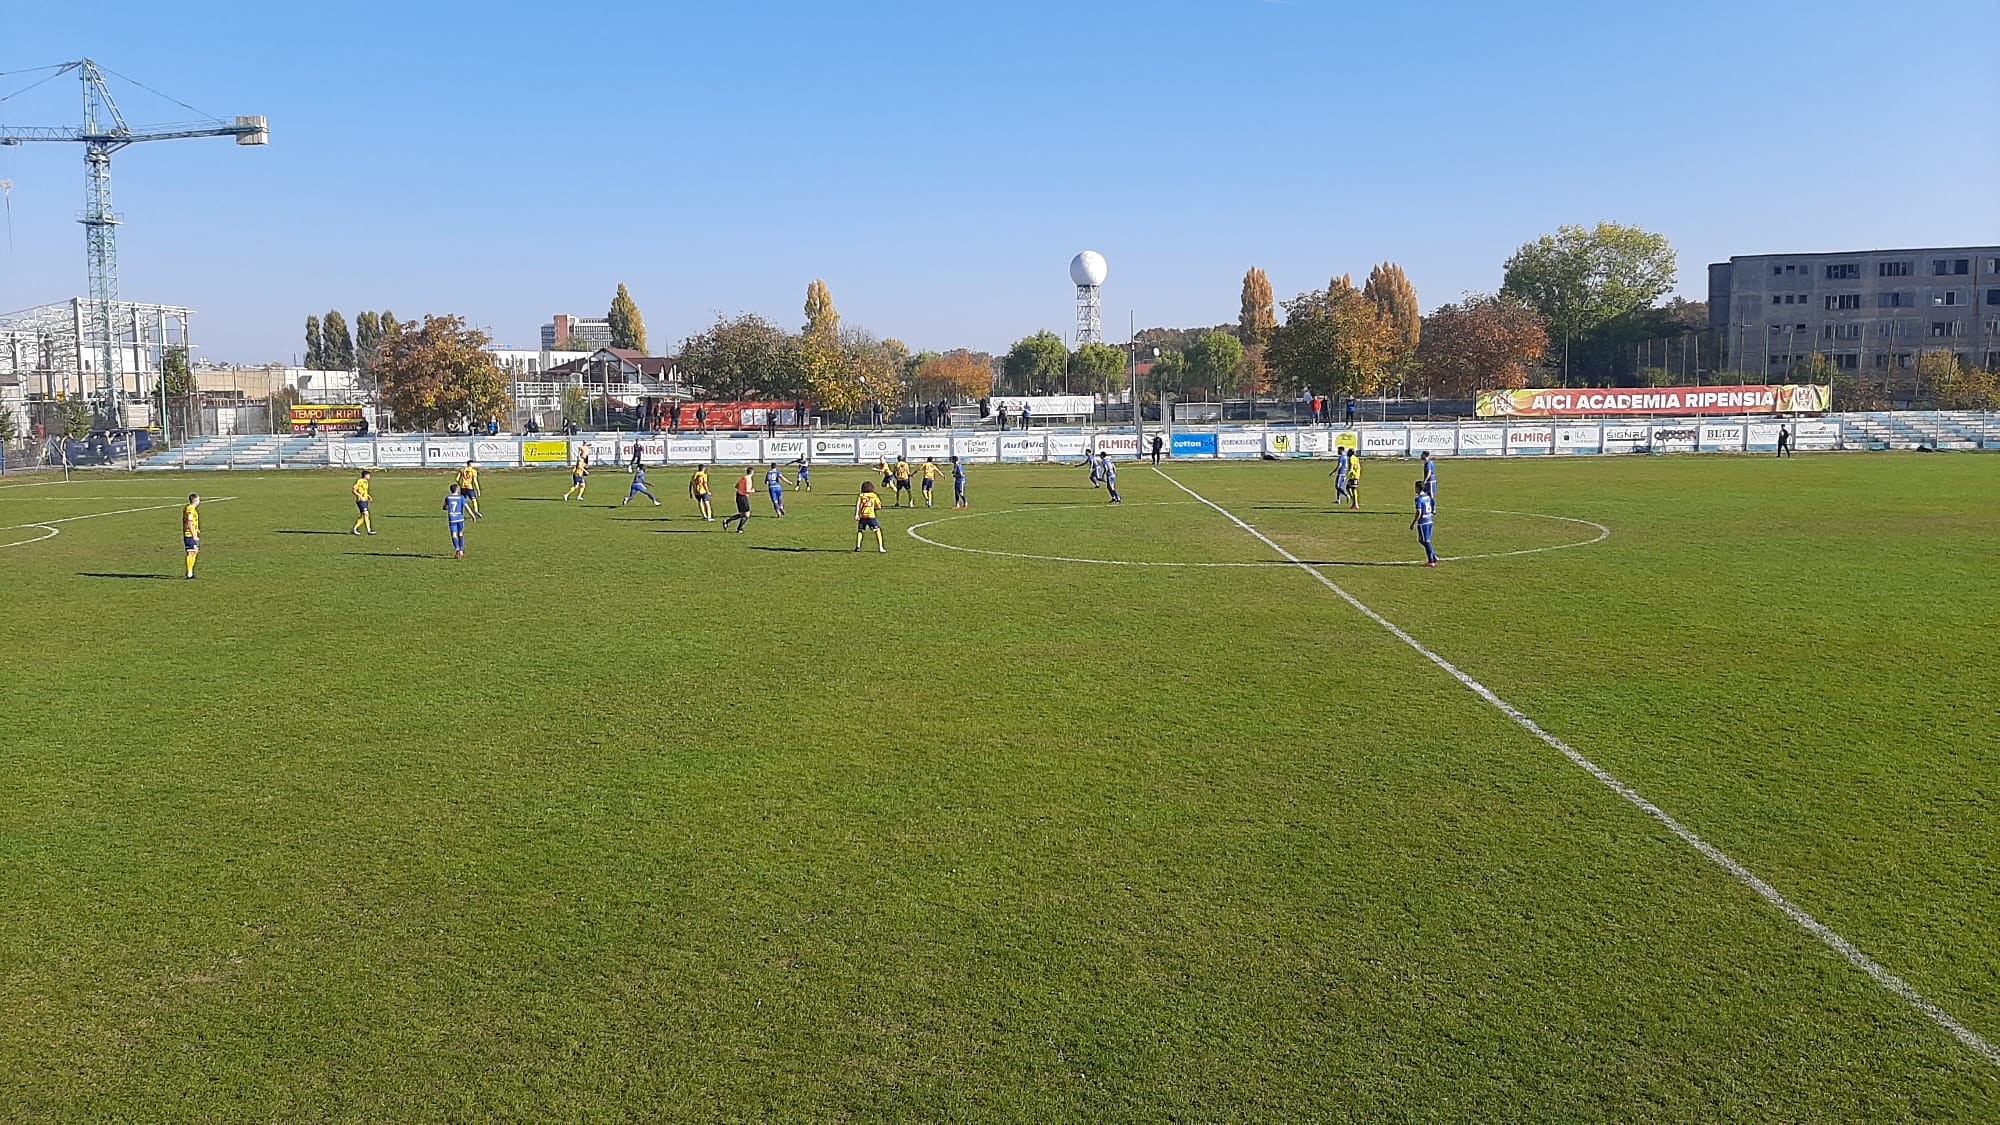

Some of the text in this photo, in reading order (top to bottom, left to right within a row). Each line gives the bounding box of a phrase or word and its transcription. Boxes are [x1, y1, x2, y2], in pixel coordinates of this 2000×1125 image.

[1532, 391, 1775, 410] AICI ACADEMIA RIPENSIA
[1367, 437, 1404, 447] natura
[1510, 432, 1551, 443] ALMIRA
[1098, 439, 1138, 450] ALMIRA
[451, 501, 458, 512] 7
